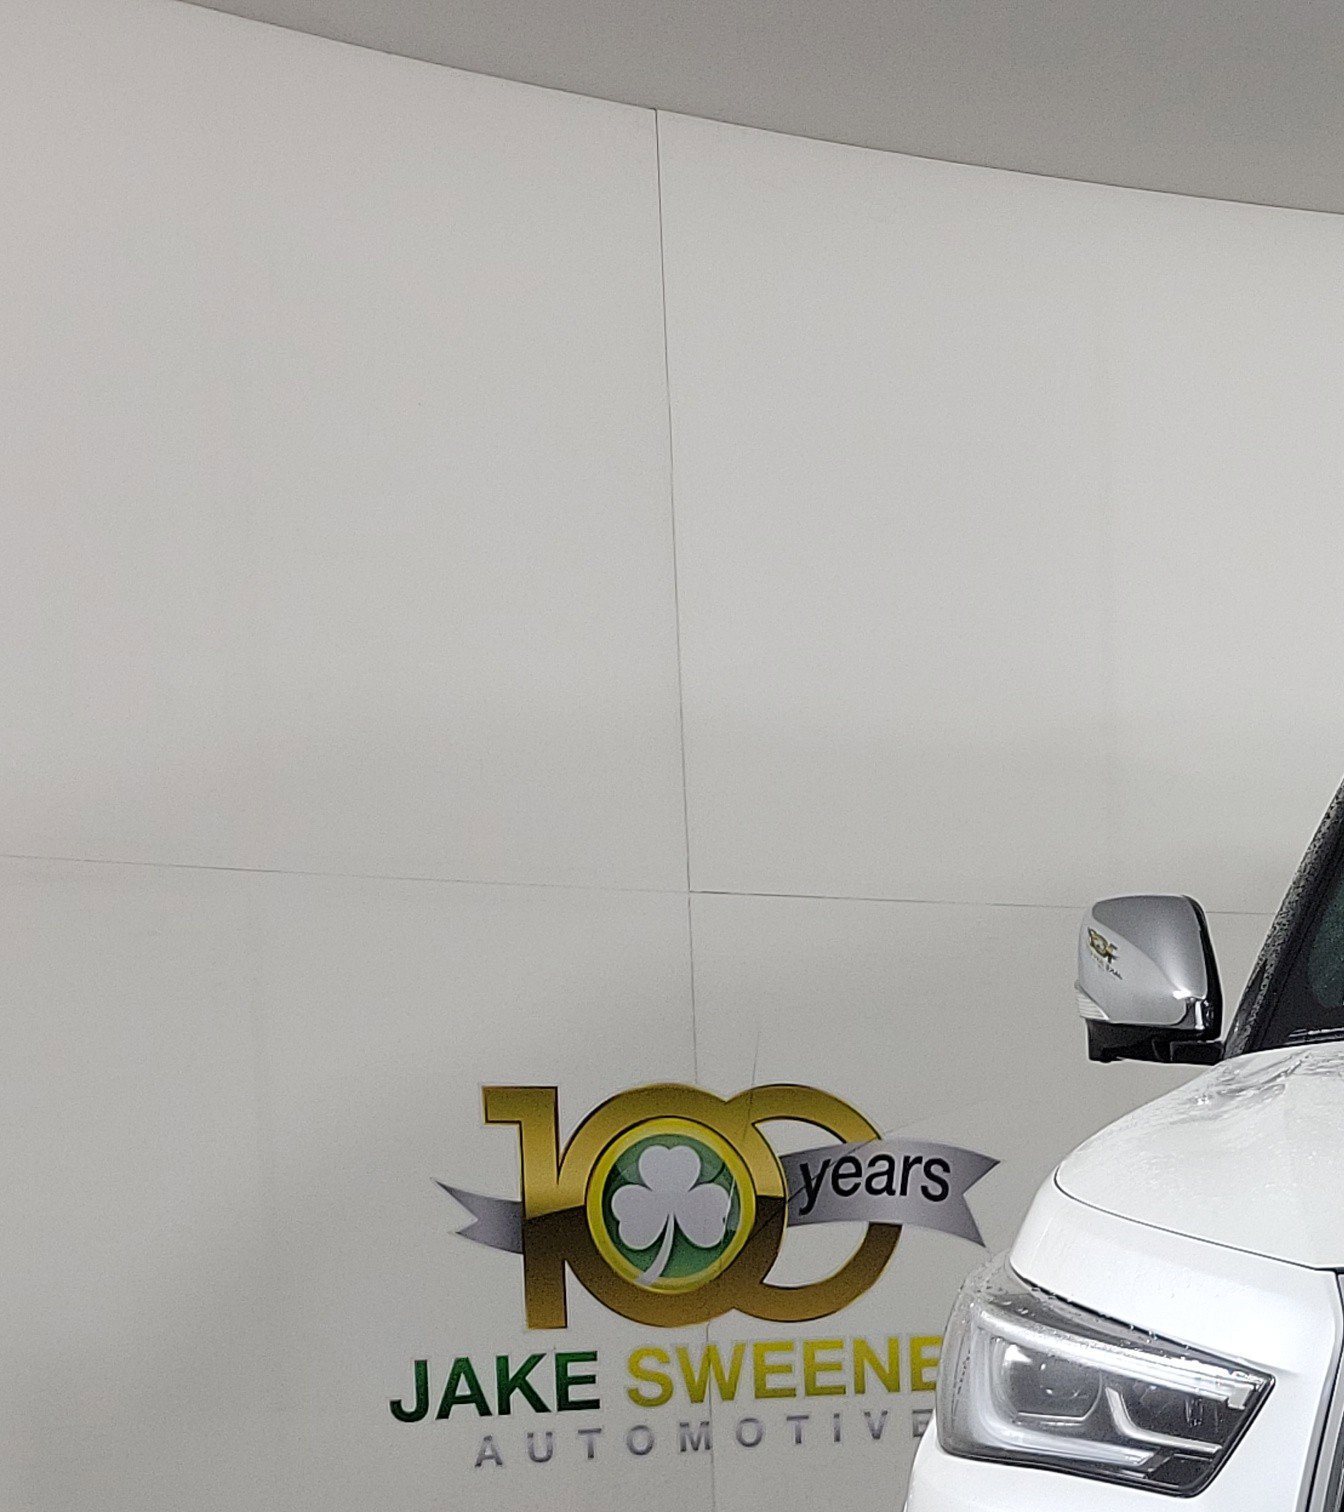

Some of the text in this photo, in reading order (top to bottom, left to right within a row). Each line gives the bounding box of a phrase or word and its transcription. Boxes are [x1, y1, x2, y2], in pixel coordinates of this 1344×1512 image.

[481, 1082, 951, 1330] 100 years
[389, 1335, 944, 1424] JAKE SWEENE
